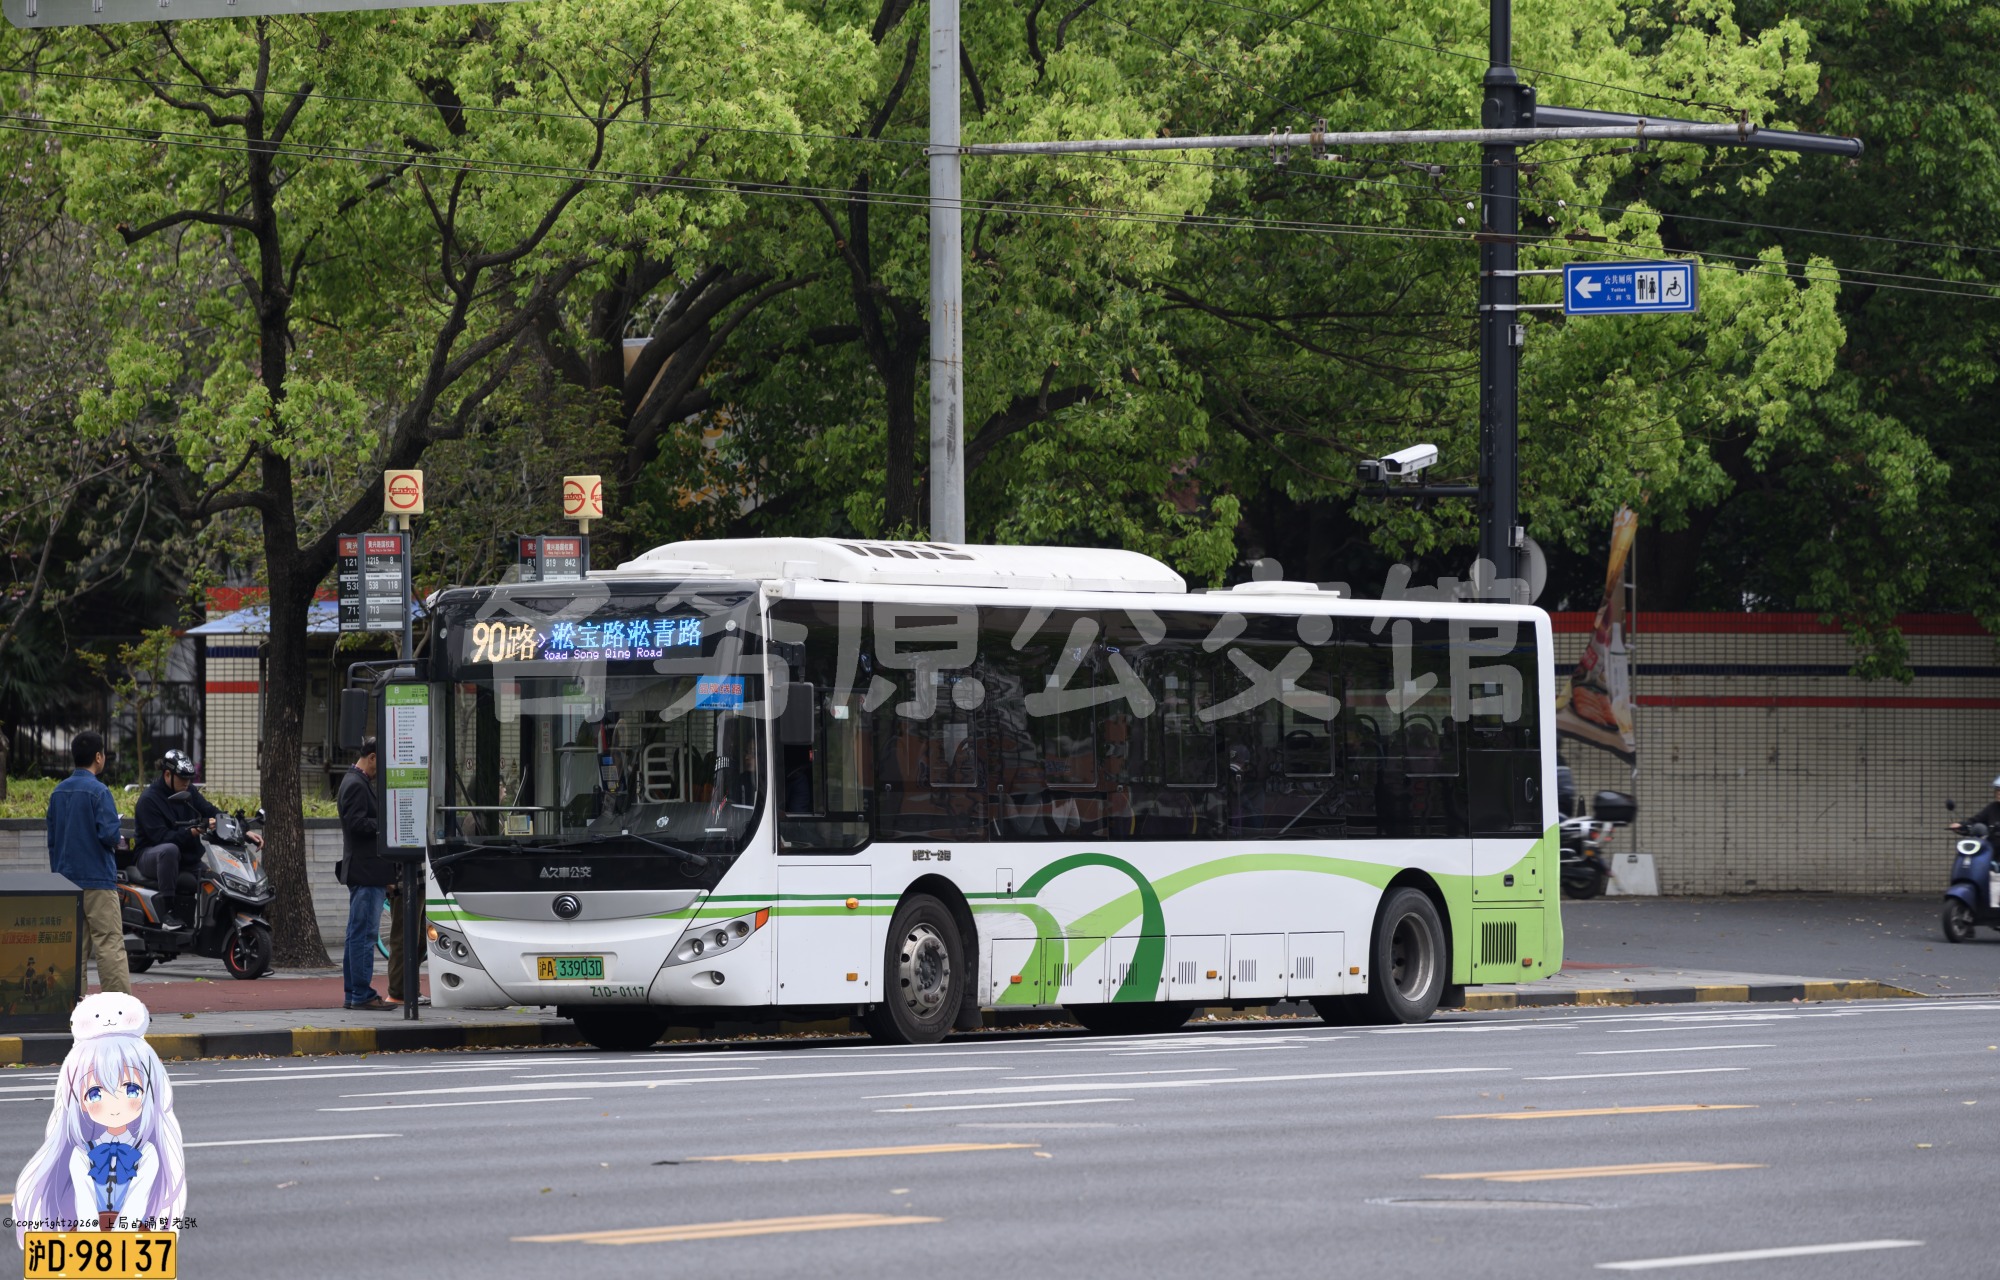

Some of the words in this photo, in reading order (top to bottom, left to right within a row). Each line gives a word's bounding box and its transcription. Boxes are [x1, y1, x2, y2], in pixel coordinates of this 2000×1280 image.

[1604, 274, 1632, 284] 公共厕所
[367, 556, 380, 565] 1215
[389, 556, 394, 565] 8
[546, 558, 556, 567] 819
[564, 558, 576, 567] 842
[368, 581, 379, 590] 538
[388, 580, 398, 590] 118
[369, 606, 380, 615] 713
[550, 618, 702, 650] 淞宝路淞青路
[472, 621, 537, 663] 90路
[573, 648, 599, 661] Song
[605, 648, 631, 660] Qing
[636, 647, 663, 658] Road
[590, 986, 645, 998] Z1D-0117
